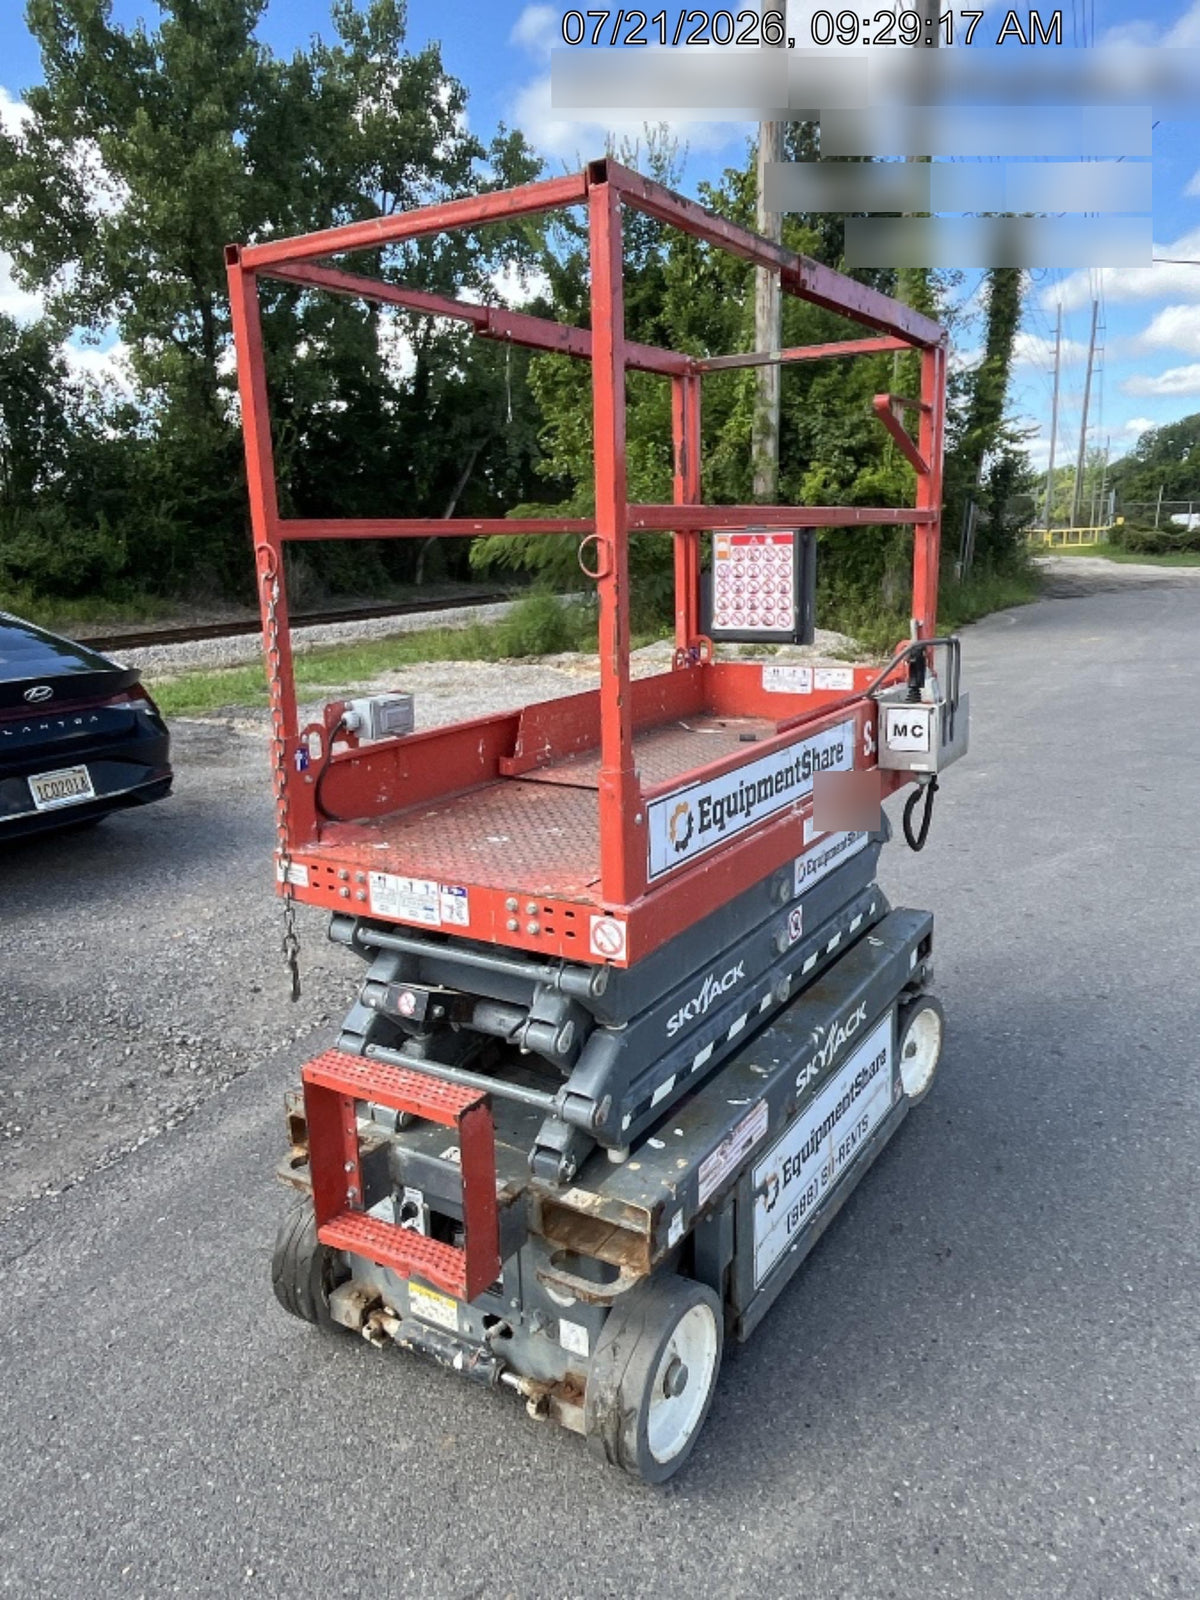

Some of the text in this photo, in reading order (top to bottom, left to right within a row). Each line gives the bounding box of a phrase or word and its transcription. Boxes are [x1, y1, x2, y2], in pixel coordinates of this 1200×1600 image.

[698, 741, 844, 834] EquipmentShare
[666, 960, 745, 1037] SKYJACK
[796, 1000, 867, 1098] SKYJACK
[782, 1047, 887, 1190] EquipmentShare
